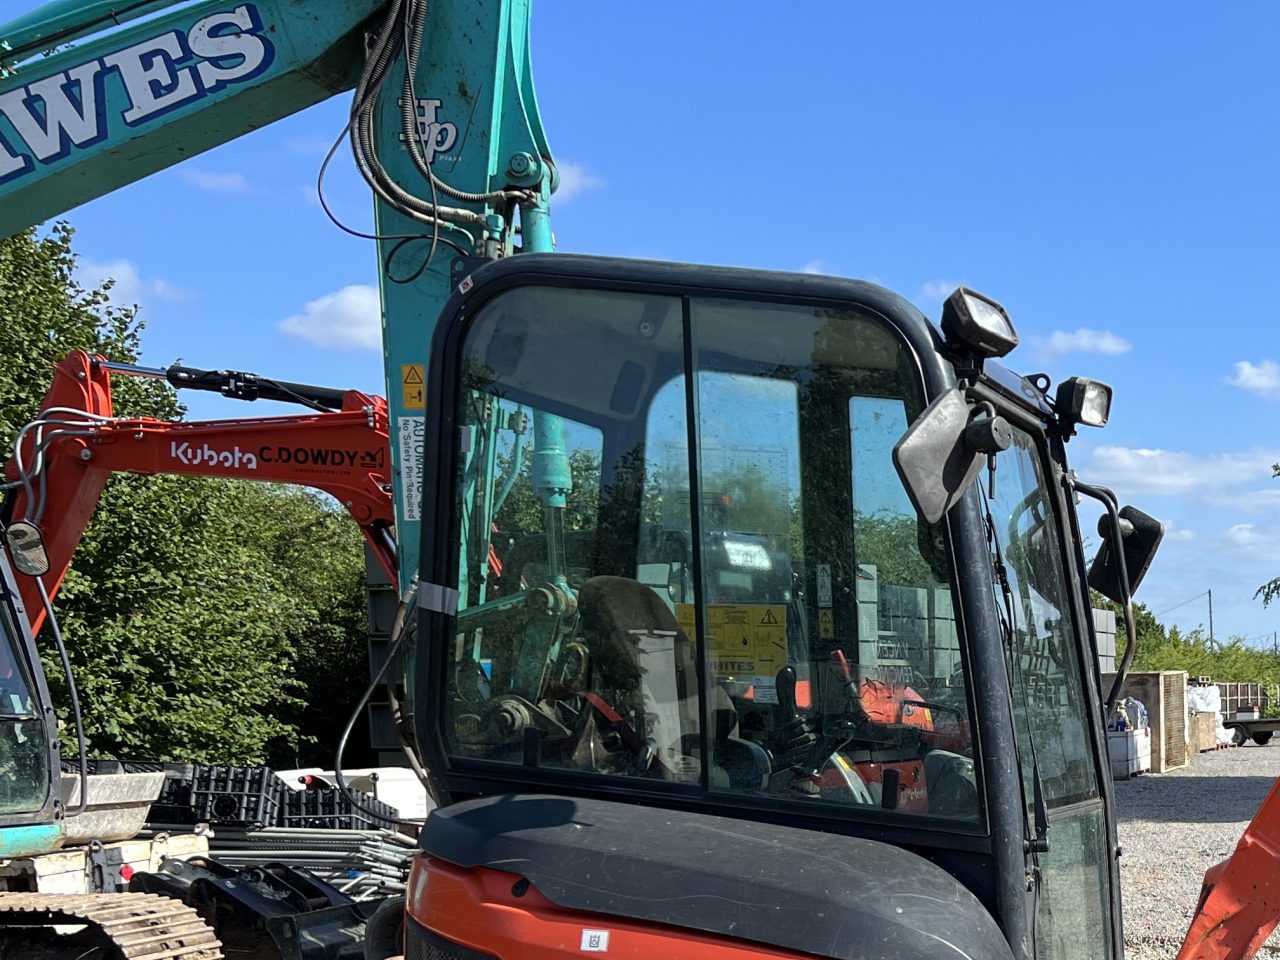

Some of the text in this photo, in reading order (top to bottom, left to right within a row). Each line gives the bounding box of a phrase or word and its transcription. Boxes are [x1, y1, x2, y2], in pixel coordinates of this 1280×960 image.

[402, 420, 410, 431] No
[171, 441, 359, 469] Kubota C.DOWDY
[403, 435, 413, 461] Safety
[406, 466, 414, 478] Pin
